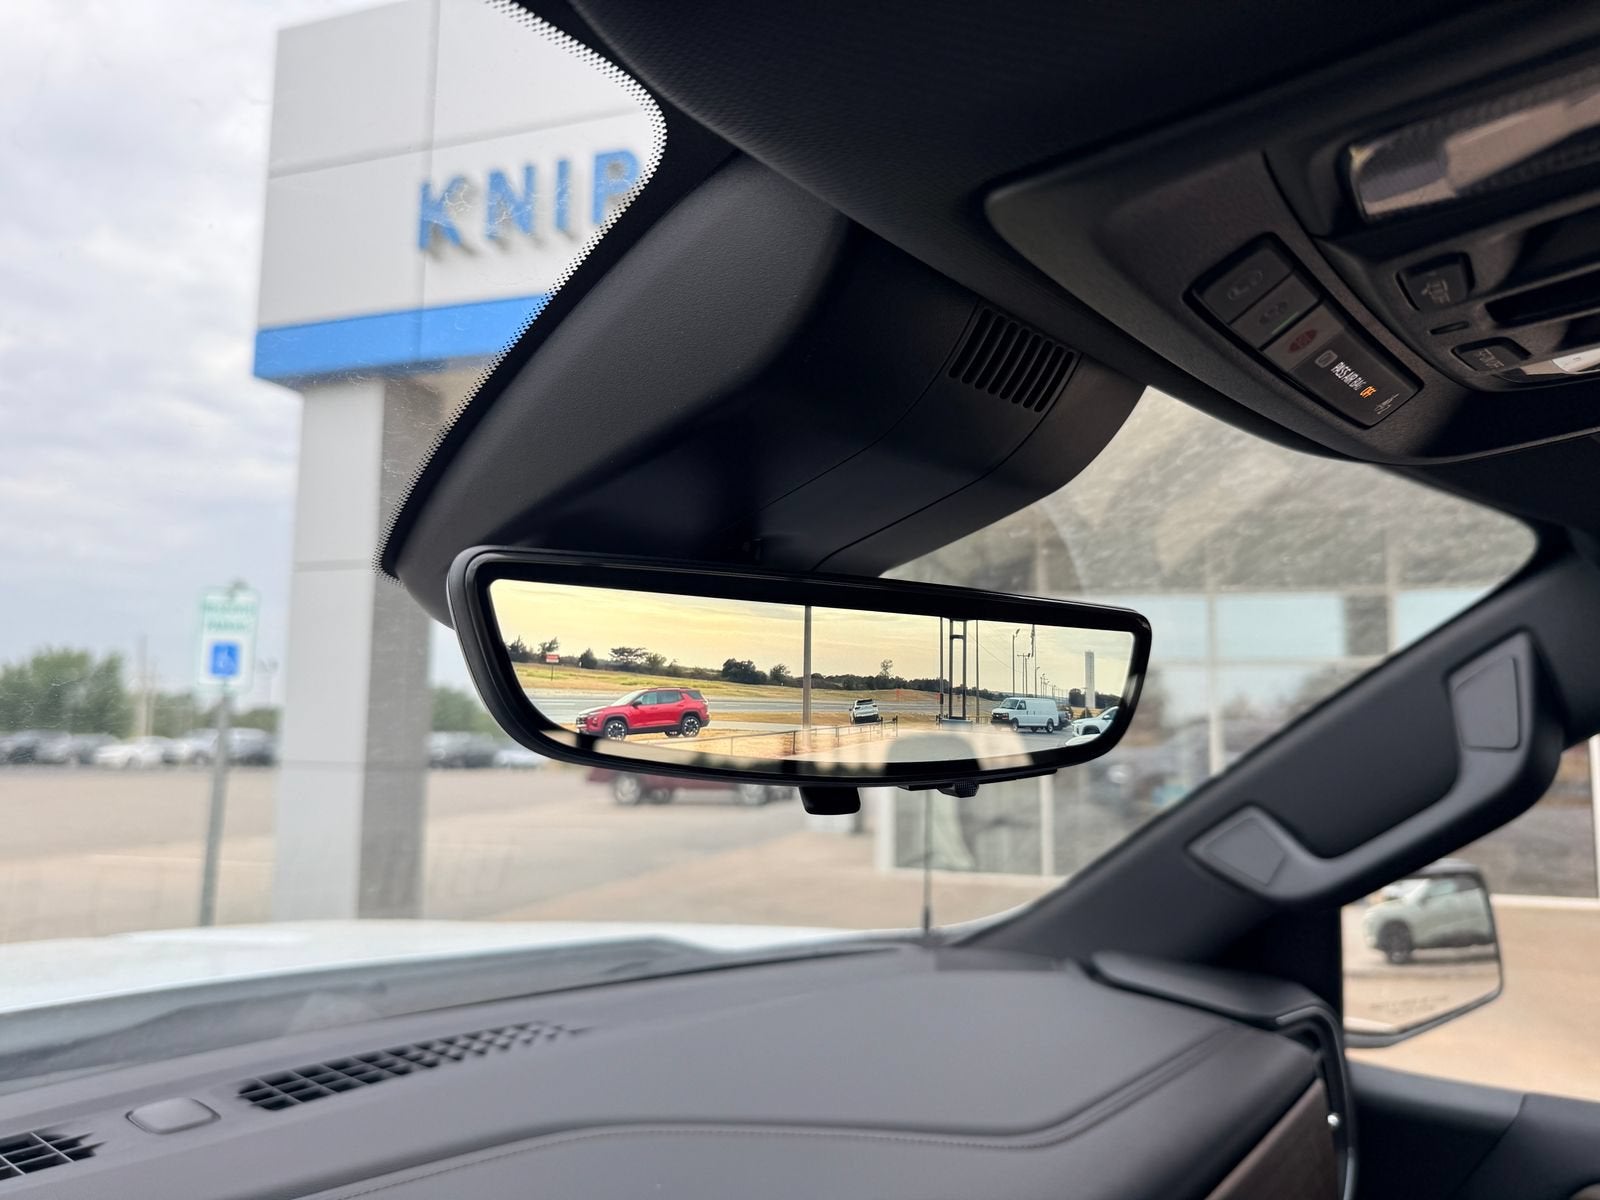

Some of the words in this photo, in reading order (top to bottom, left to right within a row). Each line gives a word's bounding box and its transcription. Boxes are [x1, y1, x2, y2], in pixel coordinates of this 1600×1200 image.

[418, 149, 640, 249] KNIP
[1331, 361, 1351, 378] PASS
[1341, 371, 1359, 385] AIR
[1349, 377, 1367, 391] BAG
[1360, 386, 1377, 398] OFF
